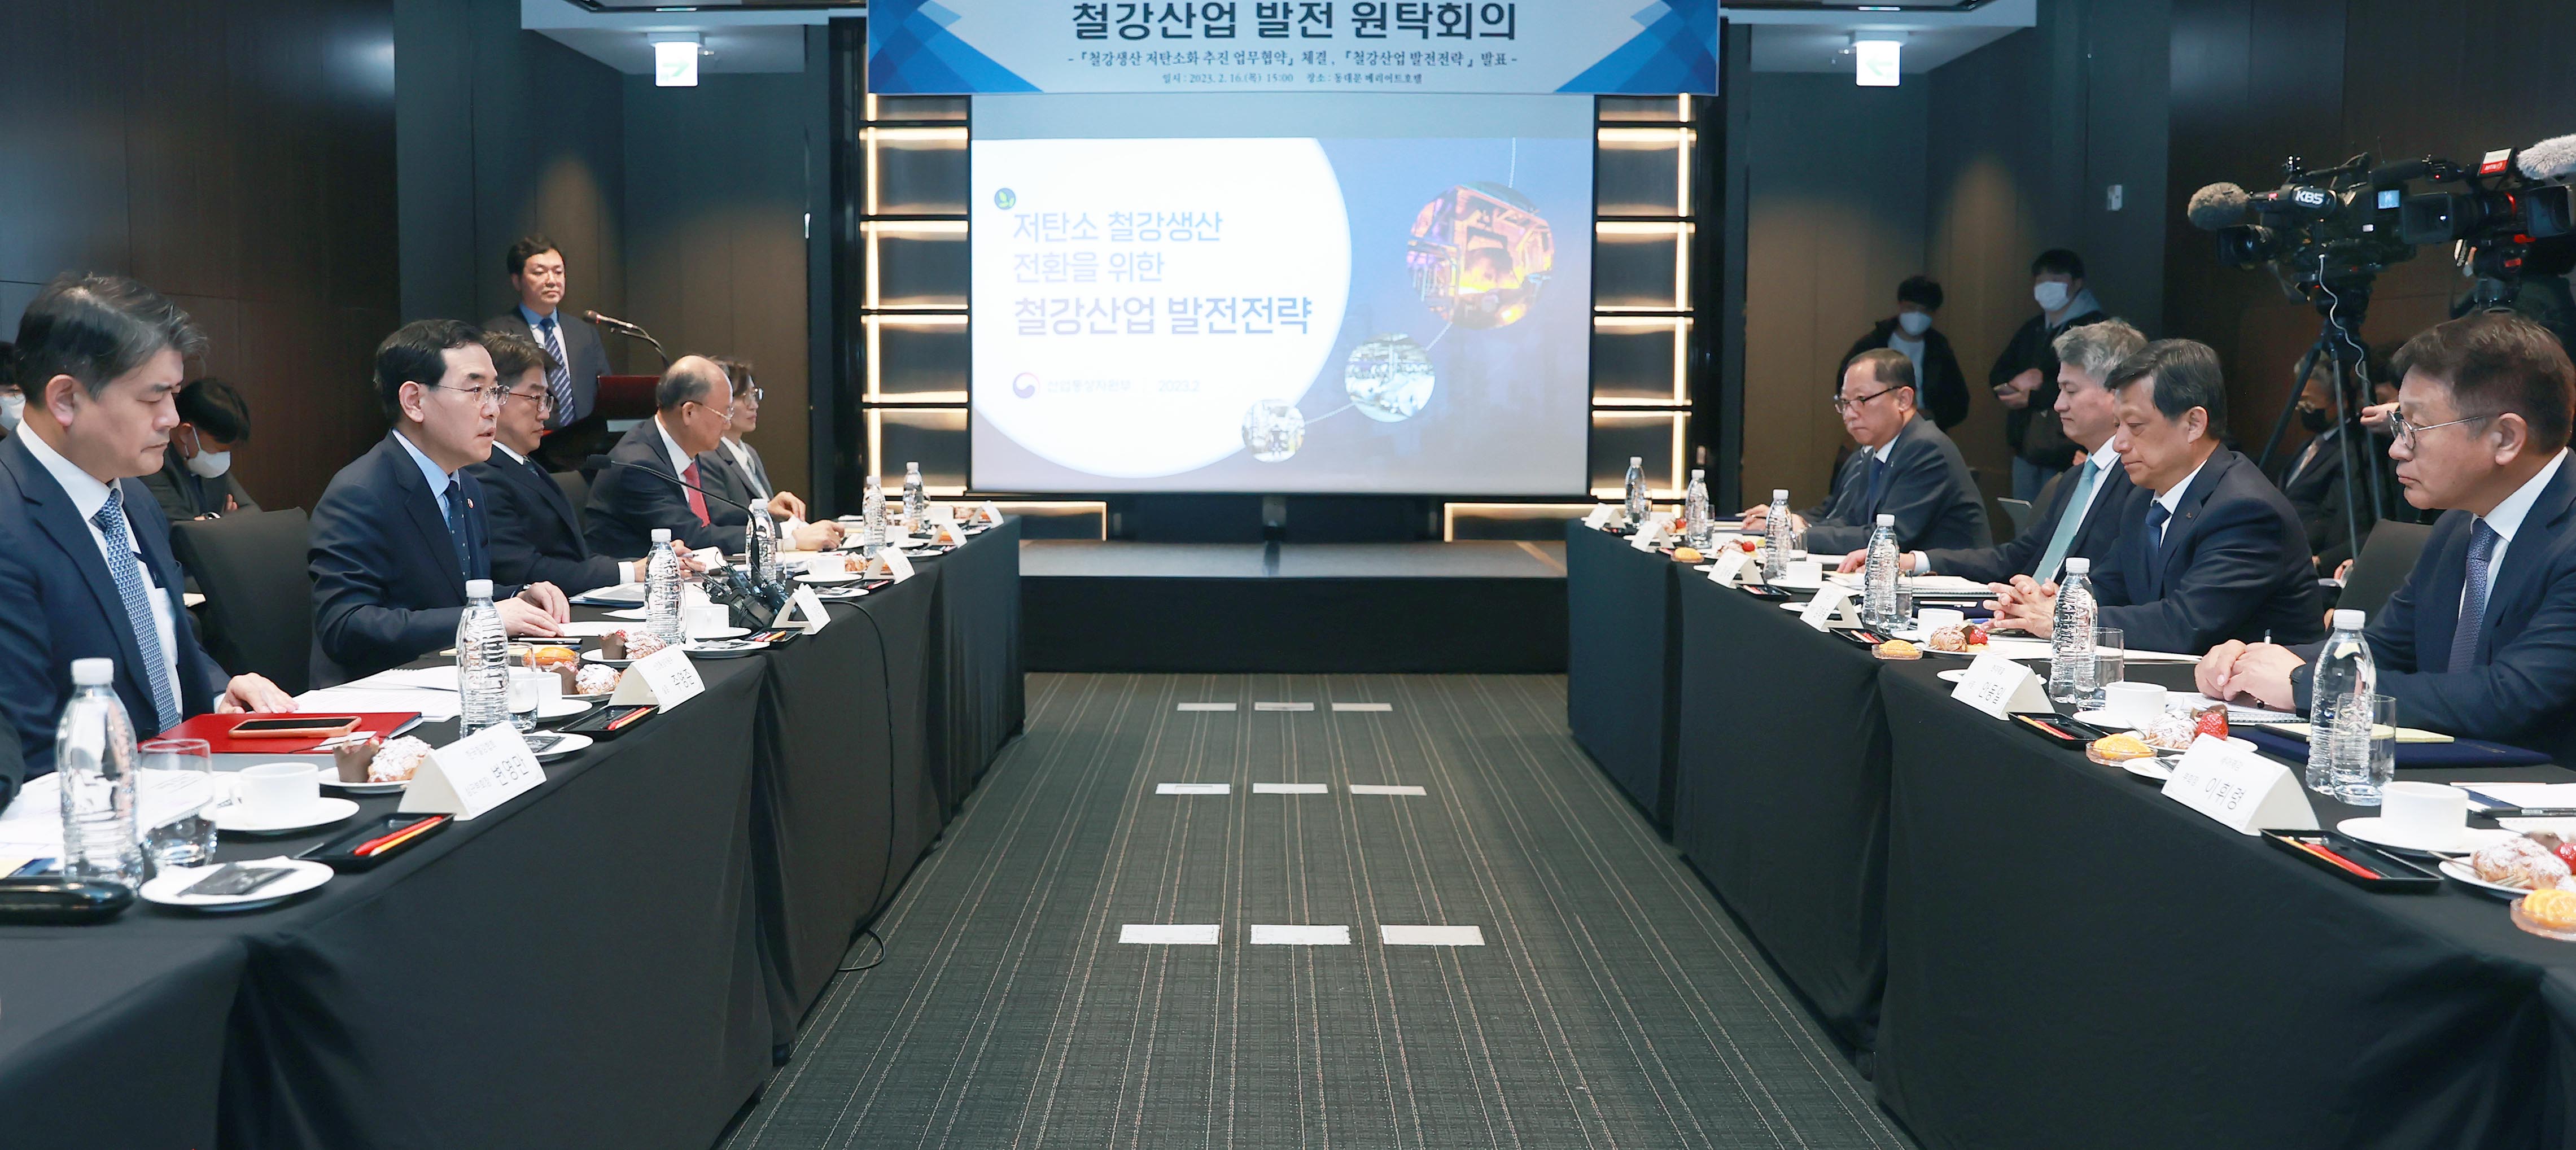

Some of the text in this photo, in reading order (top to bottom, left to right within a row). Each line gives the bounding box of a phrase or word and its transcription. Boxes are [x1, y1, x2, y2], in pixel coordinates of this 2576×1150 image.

[1073, 2, 1515, 40] 철강산업 발전 원탁회의
[1147, 51, 1200, 66] 저탄소화
[1203, 50, 1229, 65] 추진
[1481, 51, 1507, 67] 발표
[2295, 190, 2324, 205] KBS
[1013, 211, 1224, 243] 저탄소 철강생산
[1014, 251, 1165, 283] 전환을 위한
[1014, 296, 1313, 336] 철강산업 발전전략
[670, 668, 695, 692] 주영준
[1978, 681, 2006, 705] 안동일
[491, 752, 529, 786] 변영만
[2205, 777, 2247, 810] 이휘령
